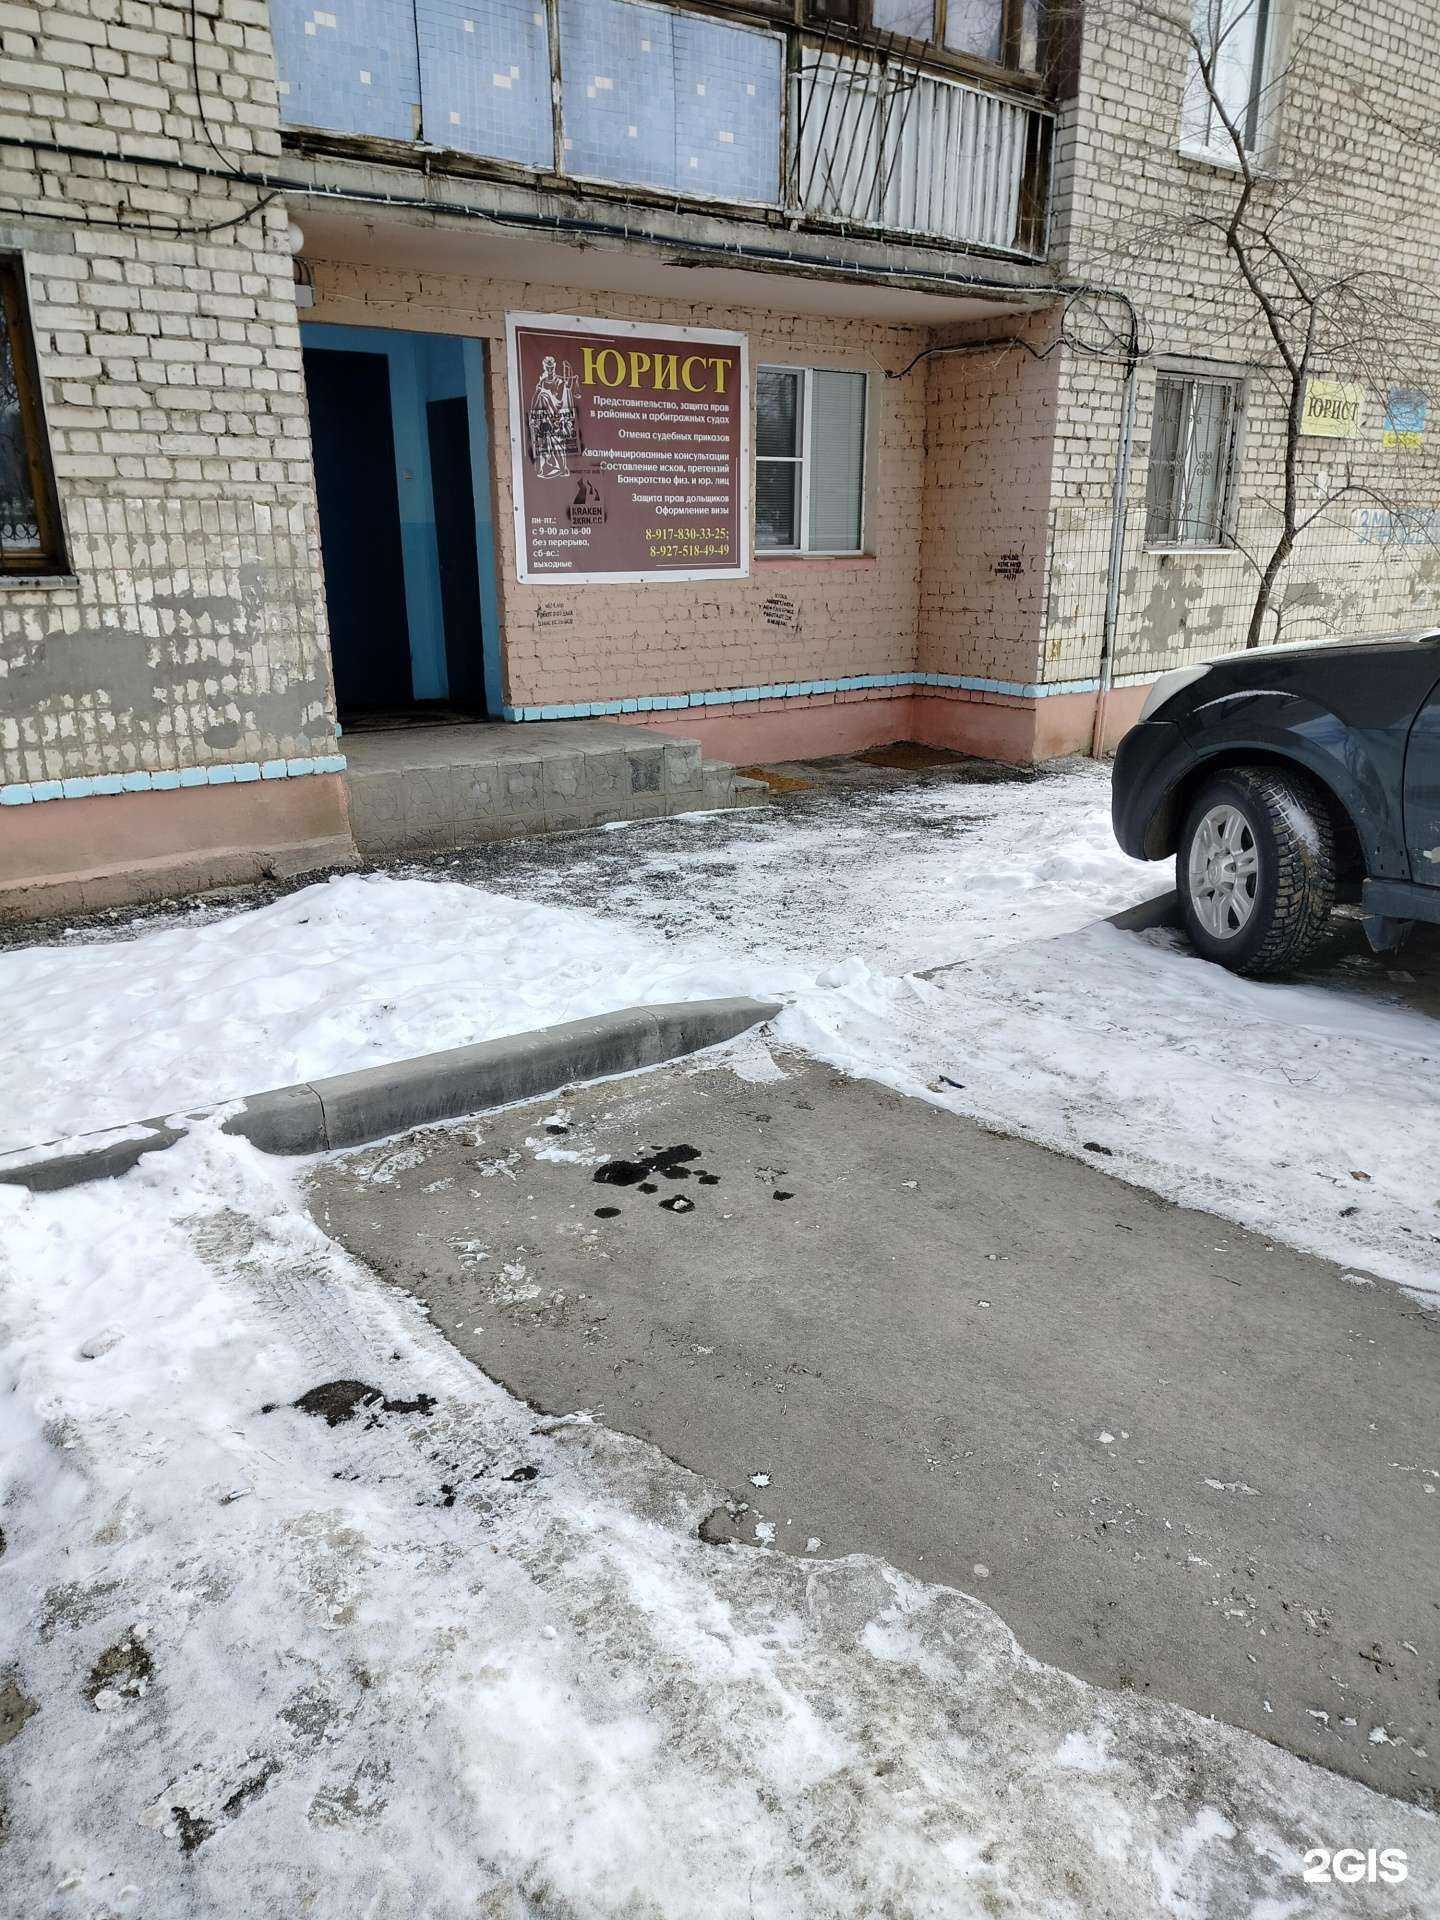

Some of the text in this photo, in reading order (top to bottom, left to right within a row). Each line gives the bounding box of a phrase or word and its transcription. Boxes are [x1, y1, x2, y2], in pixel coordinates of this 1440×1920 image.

[579, 347, 732, 394] ЮРИСТ
[593, 396, 729, 413] Представительство, защита прав
[1307, 397, 1359, 420] ЮРИСТ
[590, 409, 596, 417] в
[597, 409, 641, 420] районных
[649, 411, 705, 424] арбитражных
[706, 415, 730, 425] судах
[618, 428, 730, 443] Отмена судебных приказов
[582, 448, 730, 462] Квалифицированные консультации
[600, 460, 658, 472] Составление
[659, 464, 686, 474] исков,
[687, 464, 730, 475] претензий
[617, 475, 672, 486] Банкротство
[673, 475, 690, 486] физ.
[698, 477, 714, 487] юр.
[715, 478, 730, 487] лиц
[632, 493, 730, 504] Защита прав дольщиков
[572, 507, 602, 516] KRAKEN
[655, 505, 729, 516] Оформление визы
[539, 527, 557, 536] 9-00
[559, 528, 569, 537] до
[645, 527, 730, 541] 8-917-830-33-25;
[532, 538, 590, 548] без перерыва,
[650, 544, 730, 558] 8-927-518-49-49
[533, 561, 573, 569] выходные
